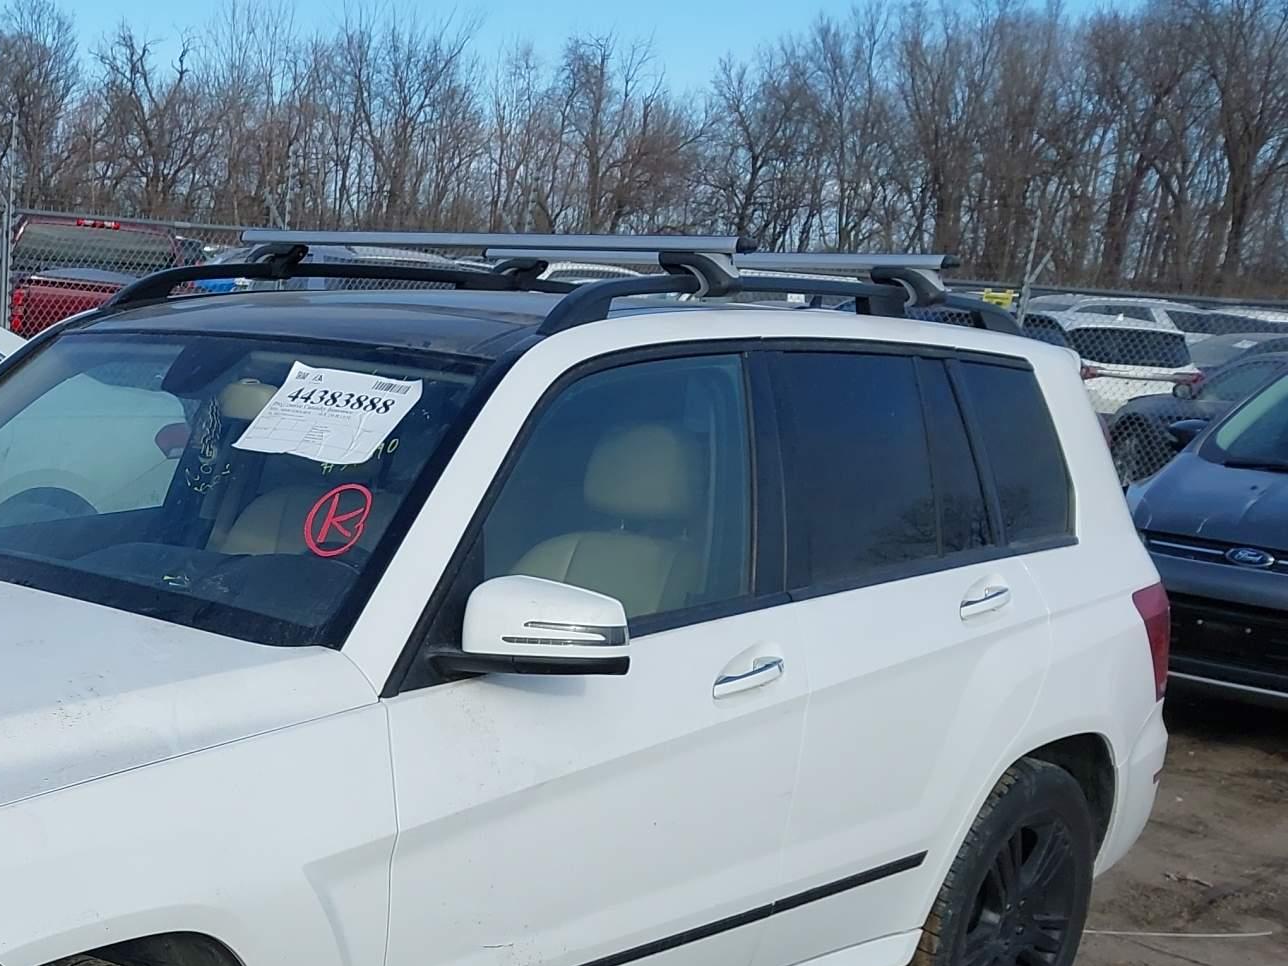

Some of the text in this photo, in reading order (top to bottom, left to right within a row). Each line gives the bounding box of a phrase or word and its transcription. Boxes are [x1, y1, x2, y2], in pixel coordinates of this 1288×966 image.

[288, 387, 395, 414] 44383888
[315, 490, 366, 546] K
[1234, 549, 1263, 561] Ford
